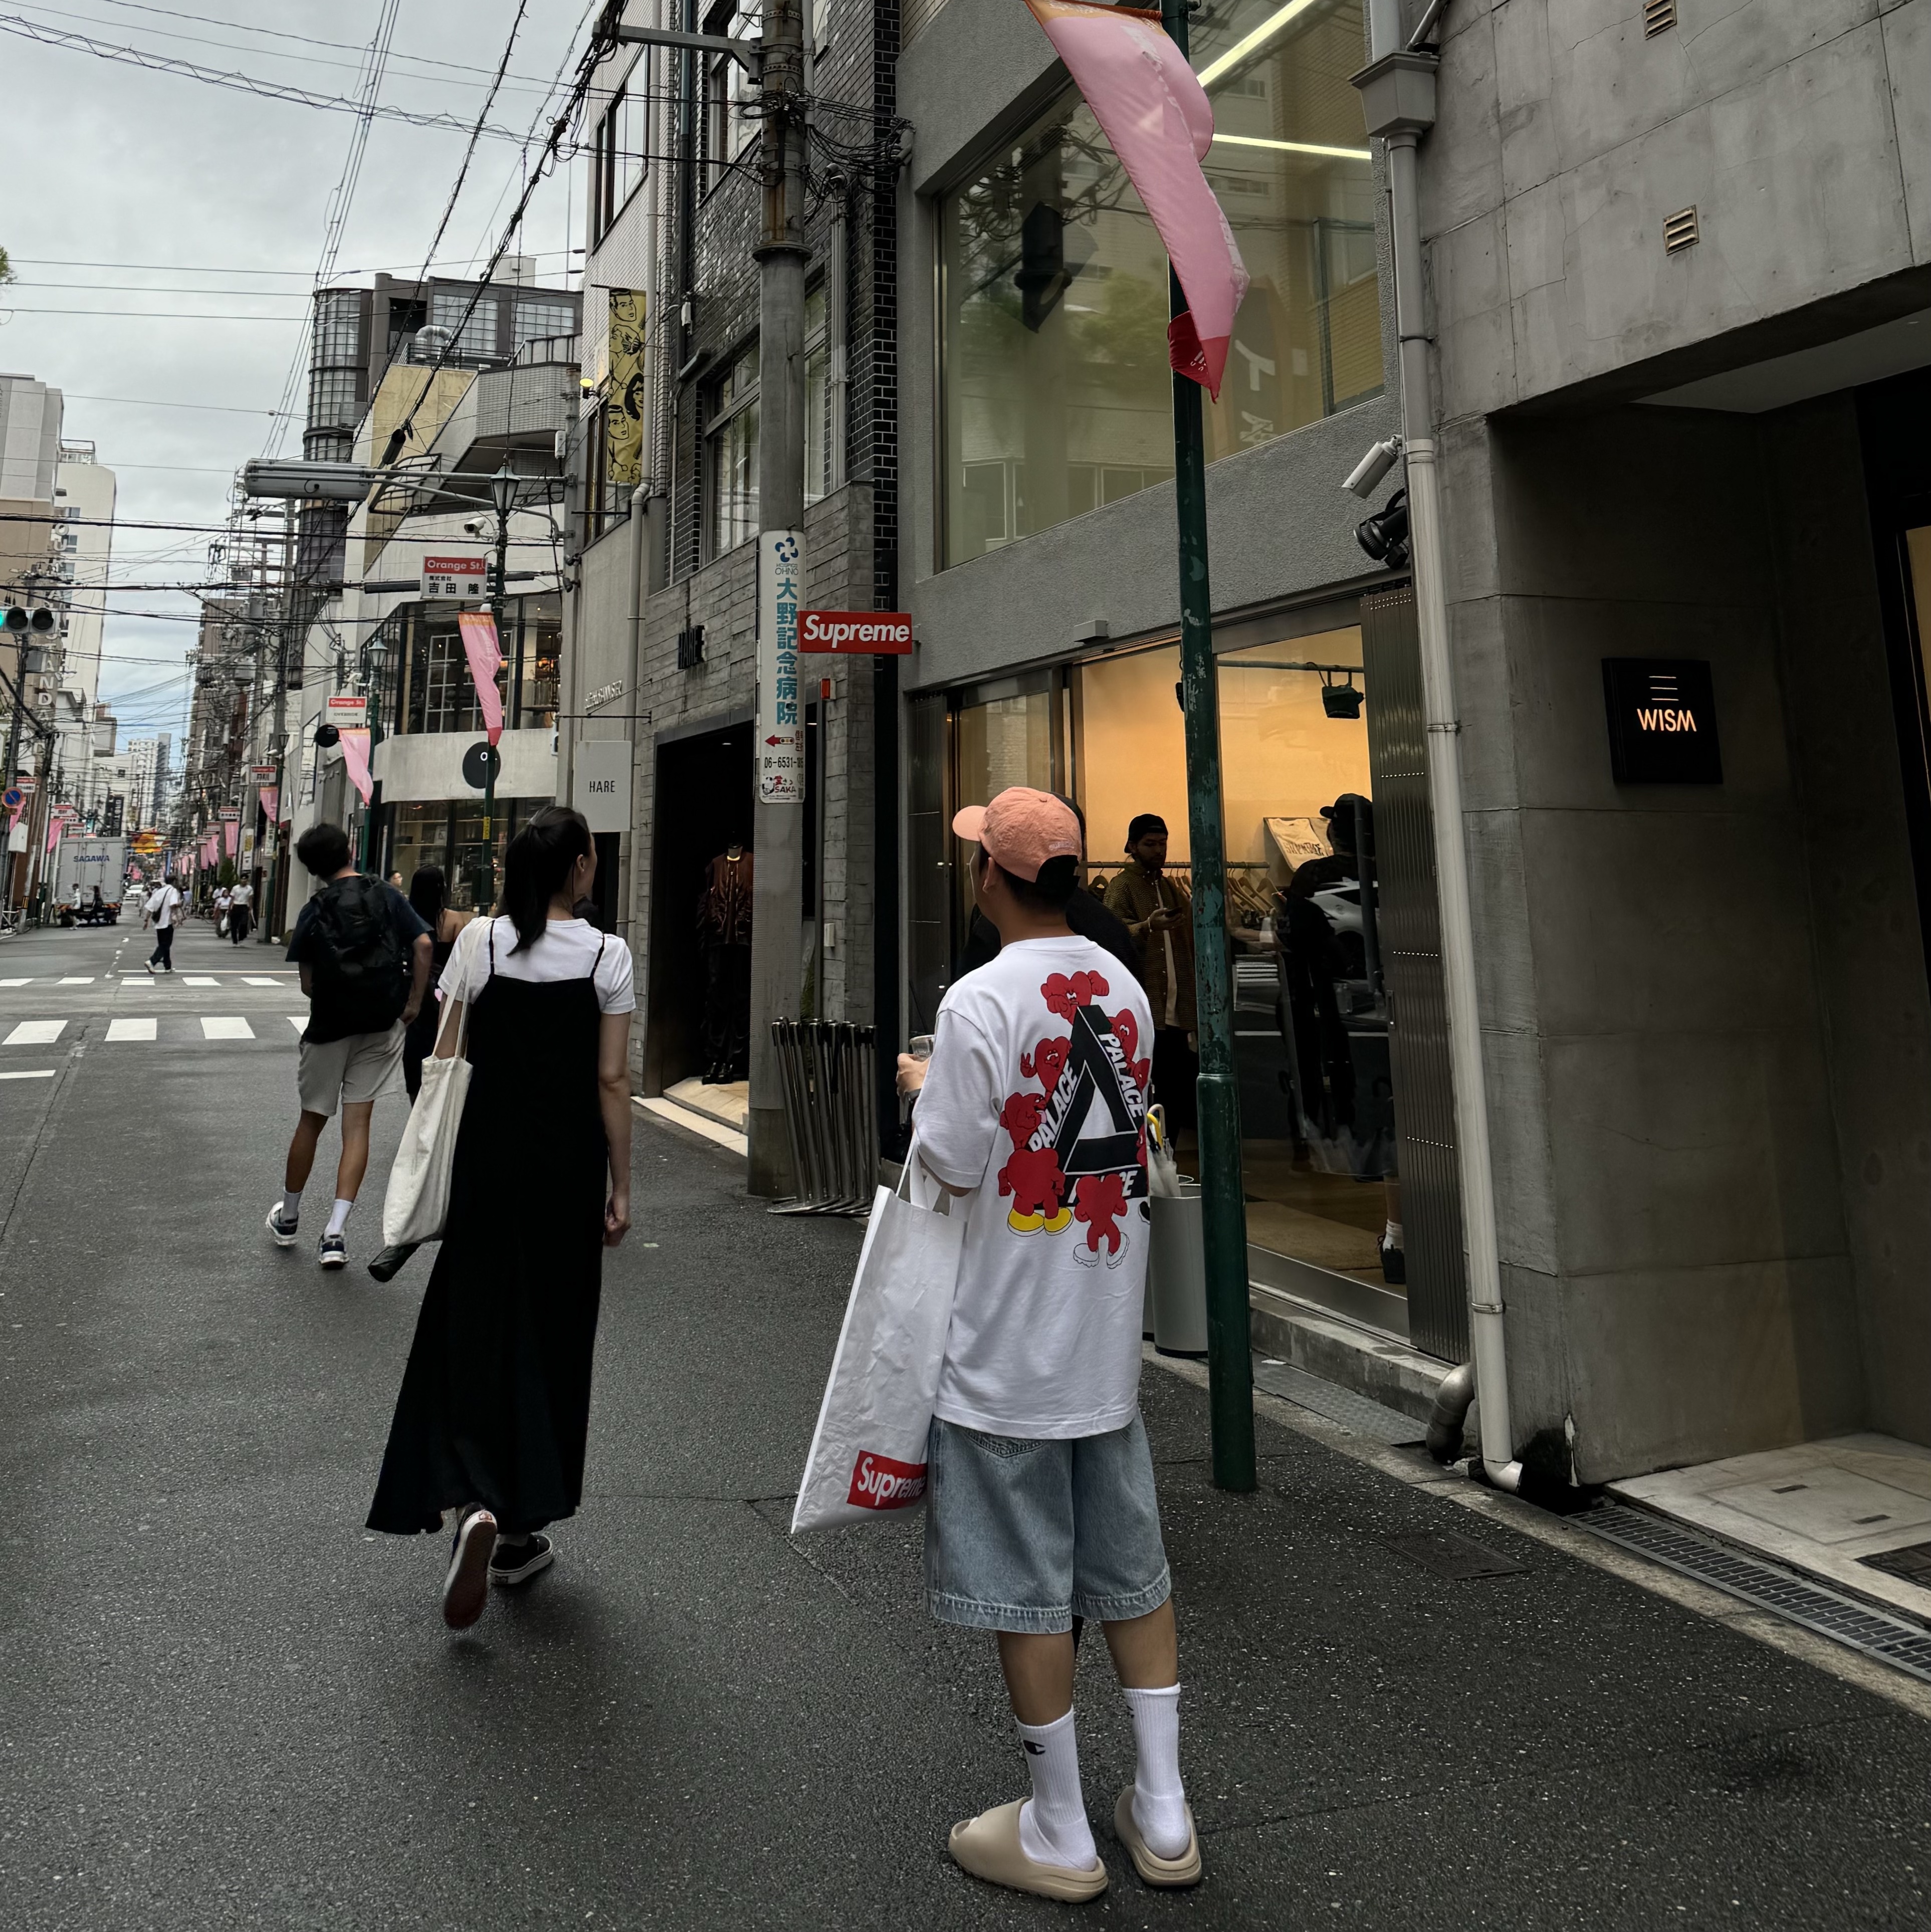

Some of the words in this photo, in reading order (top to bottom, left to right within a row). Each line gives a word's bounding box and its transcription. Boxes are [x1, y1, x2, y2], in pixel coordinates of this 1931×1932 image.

[427, 560, 467, 571] Orange
[470, 561, 482, 570] St.
[775, 567, 798, 575] OHNO
[803, 614, 910, 649] Supreme
[776, 577, 798, 725] 大野記念病院
[1637, 708, 1697, 732] WISM
[589, 780, 615, 793] HARE
[1098, 1033, 1145, 1118] PALACE
[1028, 1058, 1078, 1152] PALACE
